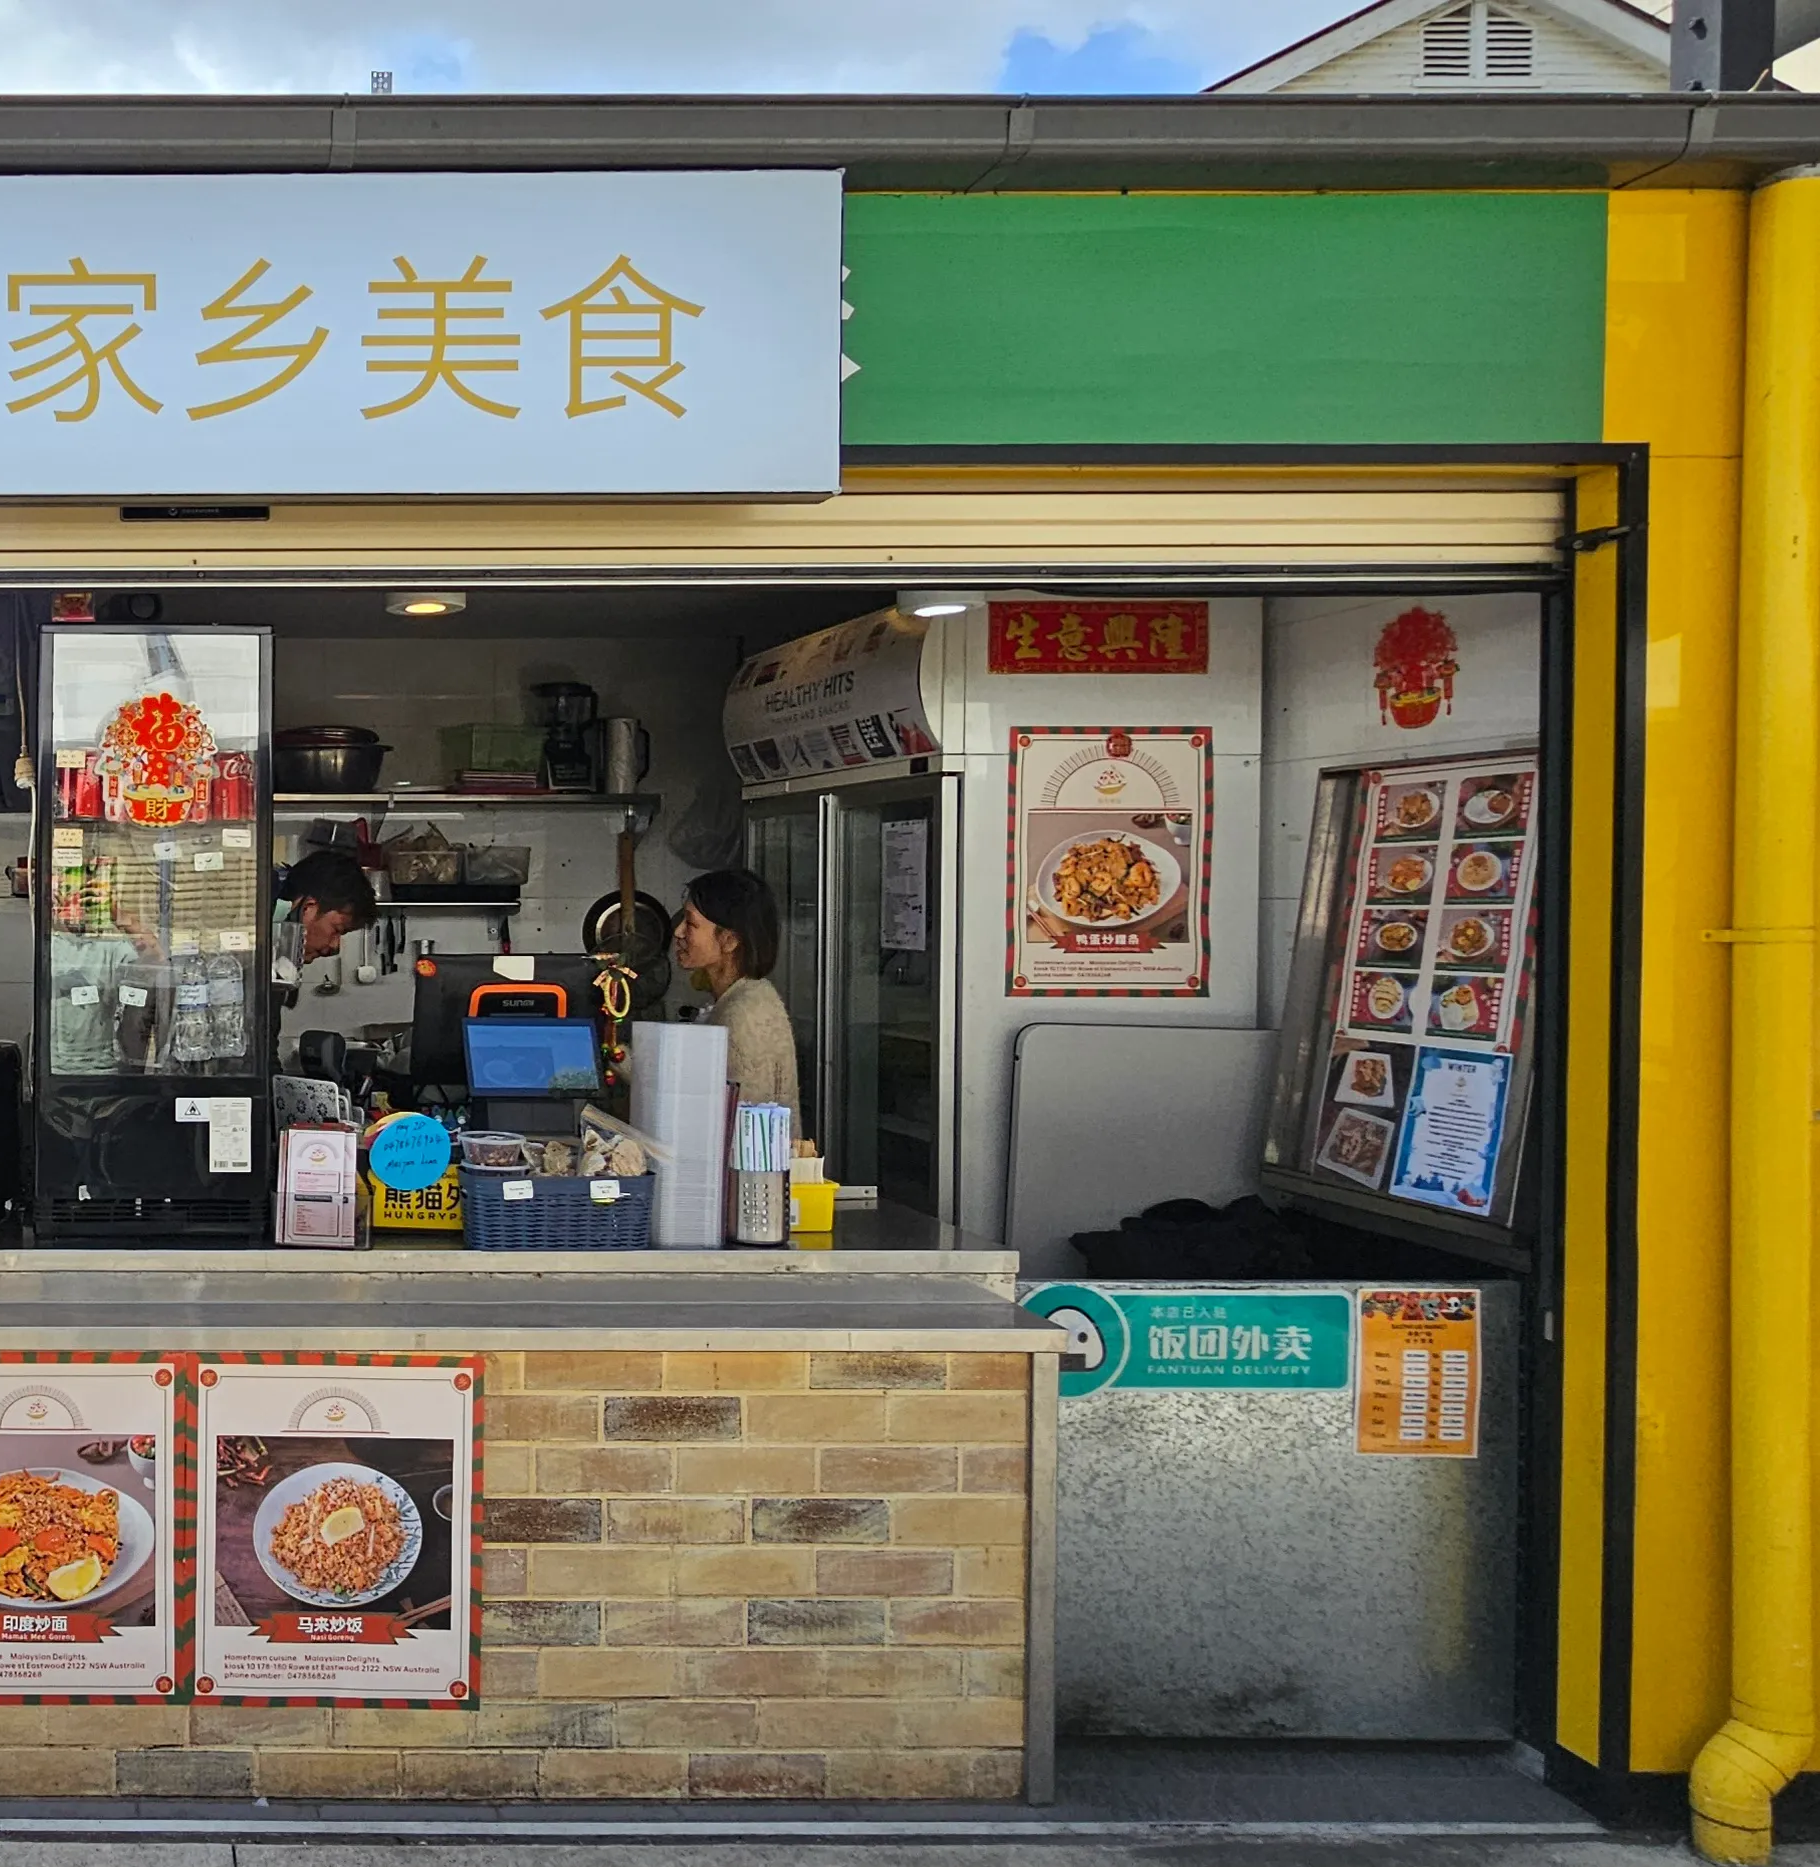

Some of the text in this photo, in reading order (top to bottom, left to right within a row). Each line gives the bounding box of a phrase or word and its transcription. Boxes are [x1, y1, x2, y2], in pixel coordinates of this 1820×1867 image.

[4, 253, 706, 423] 家乡美食
[1006, 612, 1190, 661] 生意興隆
[765, 670, 854, 714] HEALTHY HITS
[131, 692, 185, 751] 福
[146, 800, 168, 818] 財
[1448, 1063, 1477, 1073] WINTER
[384, 1212, 463, 1220] HUNGRYP
[1148, 1325, 1312, 1361] 饭团外卖
[1147, 1365, 1311, 1375] FANTUAN DELIVERY
[3, 1615, 68, 1631] 印度炒面
[297, 1617, 363, 1633] 马来炒饭
[49, 1633, 76, 1642] Goreng
[329, 1634, 354, 1642] Goreng
[11, 1653, 51, 1661] Malaysian
[304, 1655, 345, 1663] Malaysian
[27, 1662, 65, 1670] Eastwood
[67, 1662, 86, 1670] 2122
[109, 1662, 145, 1670] Australia
[362, 1664, 380, 1672] 2122
[224, 1672, 249, 1680] phone
